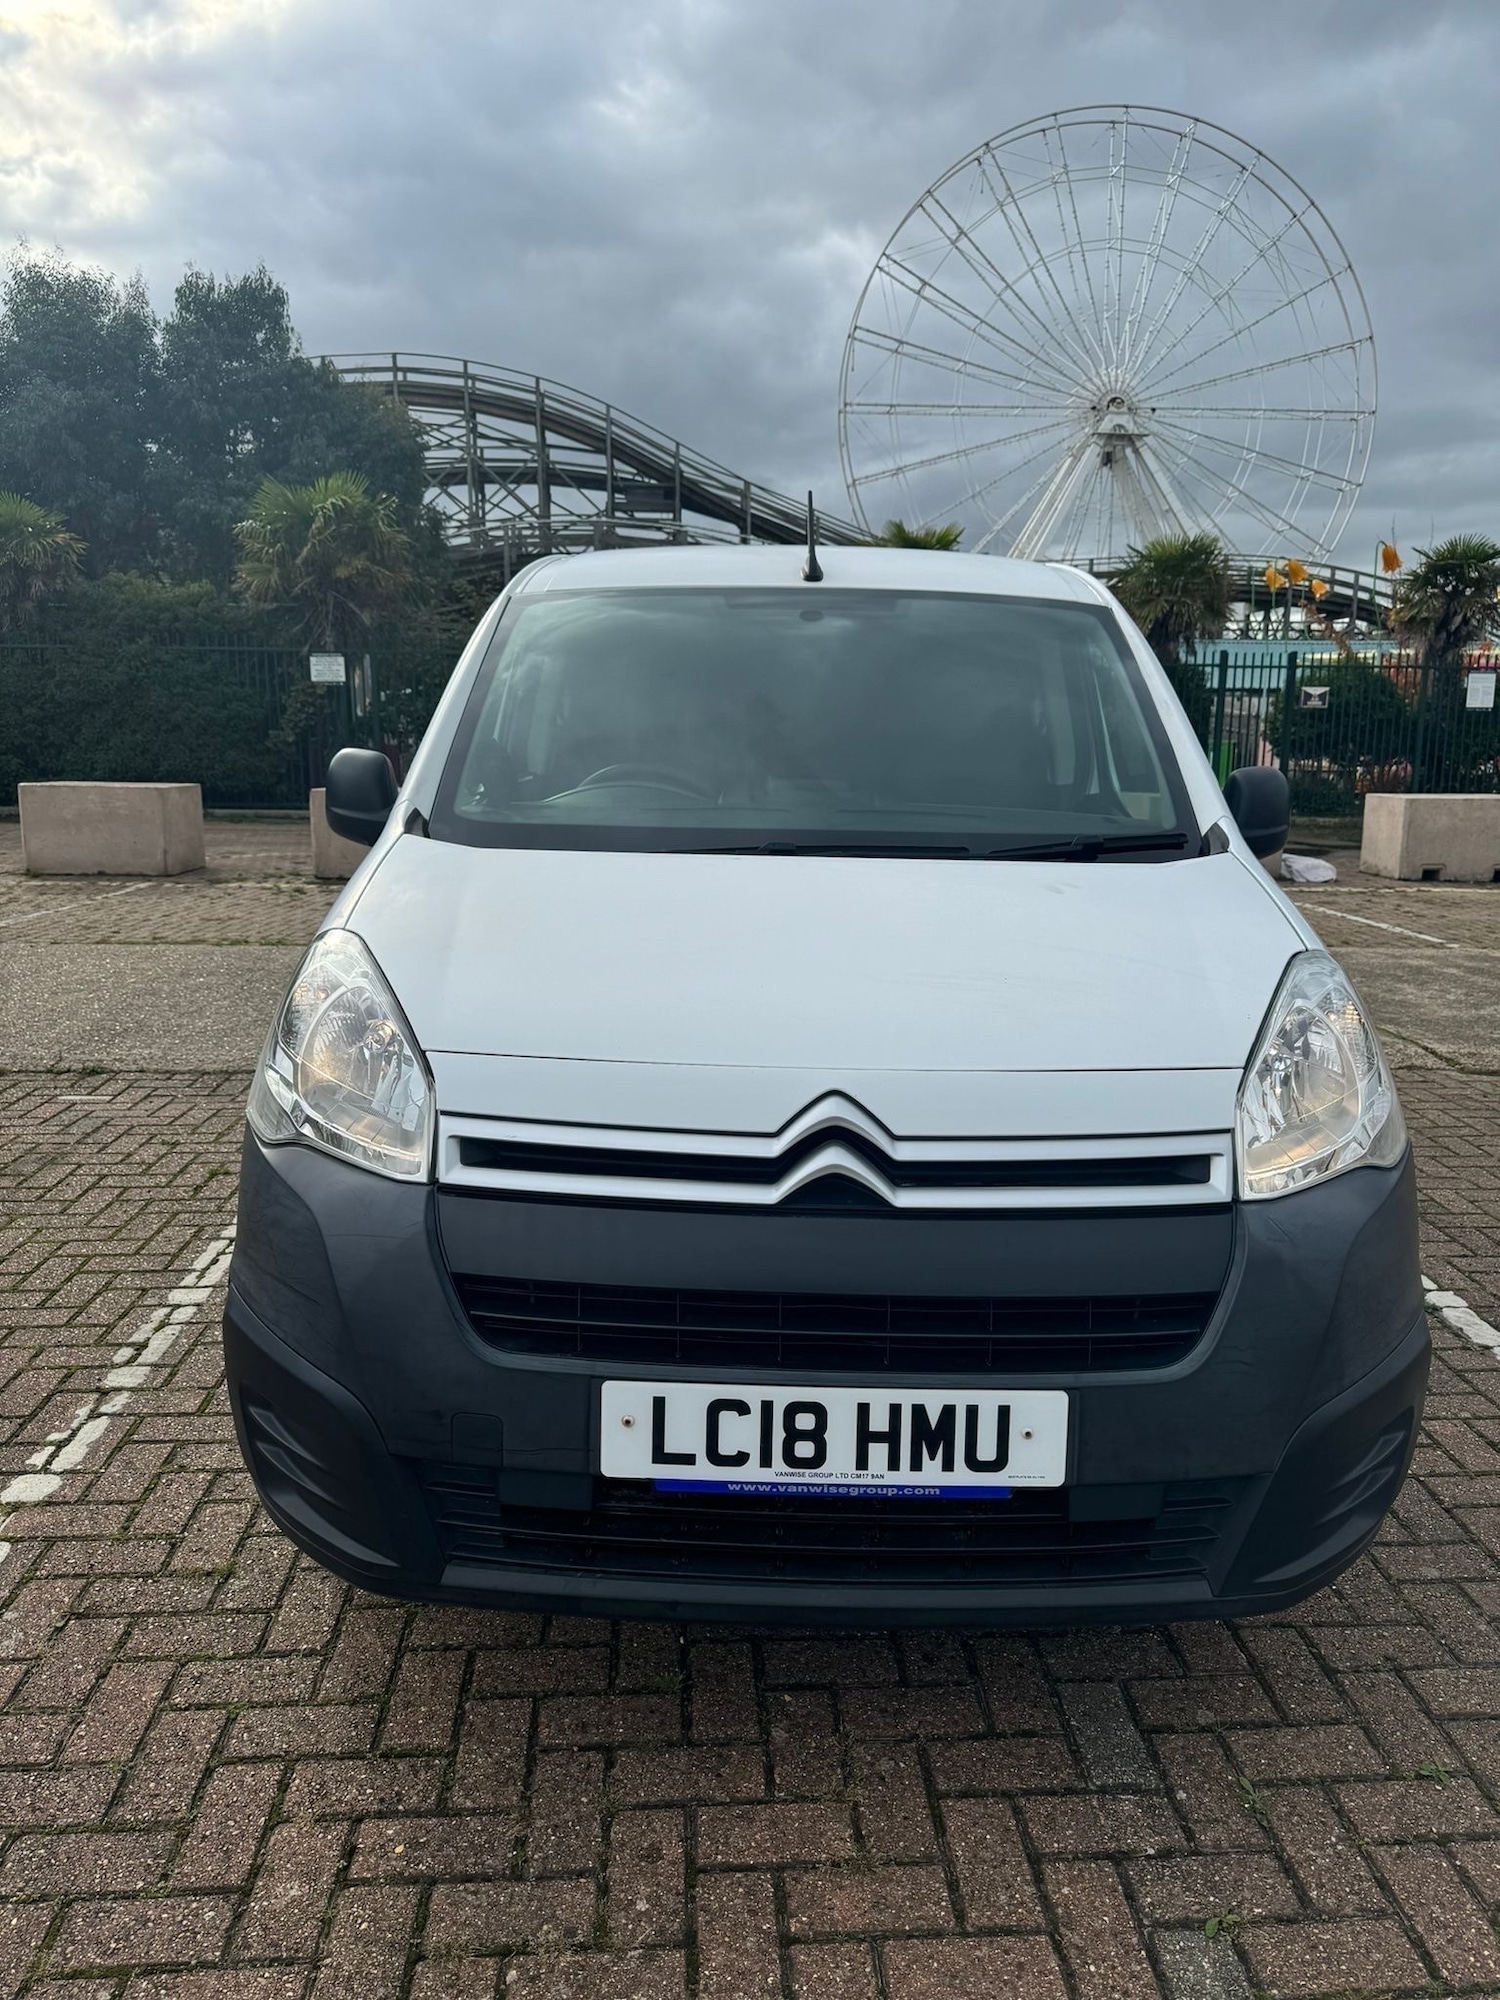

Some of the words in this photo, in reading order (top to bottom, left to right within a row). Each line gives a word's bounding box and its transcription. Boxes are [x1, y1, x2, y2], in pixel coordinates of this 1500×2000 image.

[651, 1395, 828, 1470] LC18
[855, 1402, 1011, 1473] HMU
[727, 1482, 940, 1497] www.vanwisegroup.com
